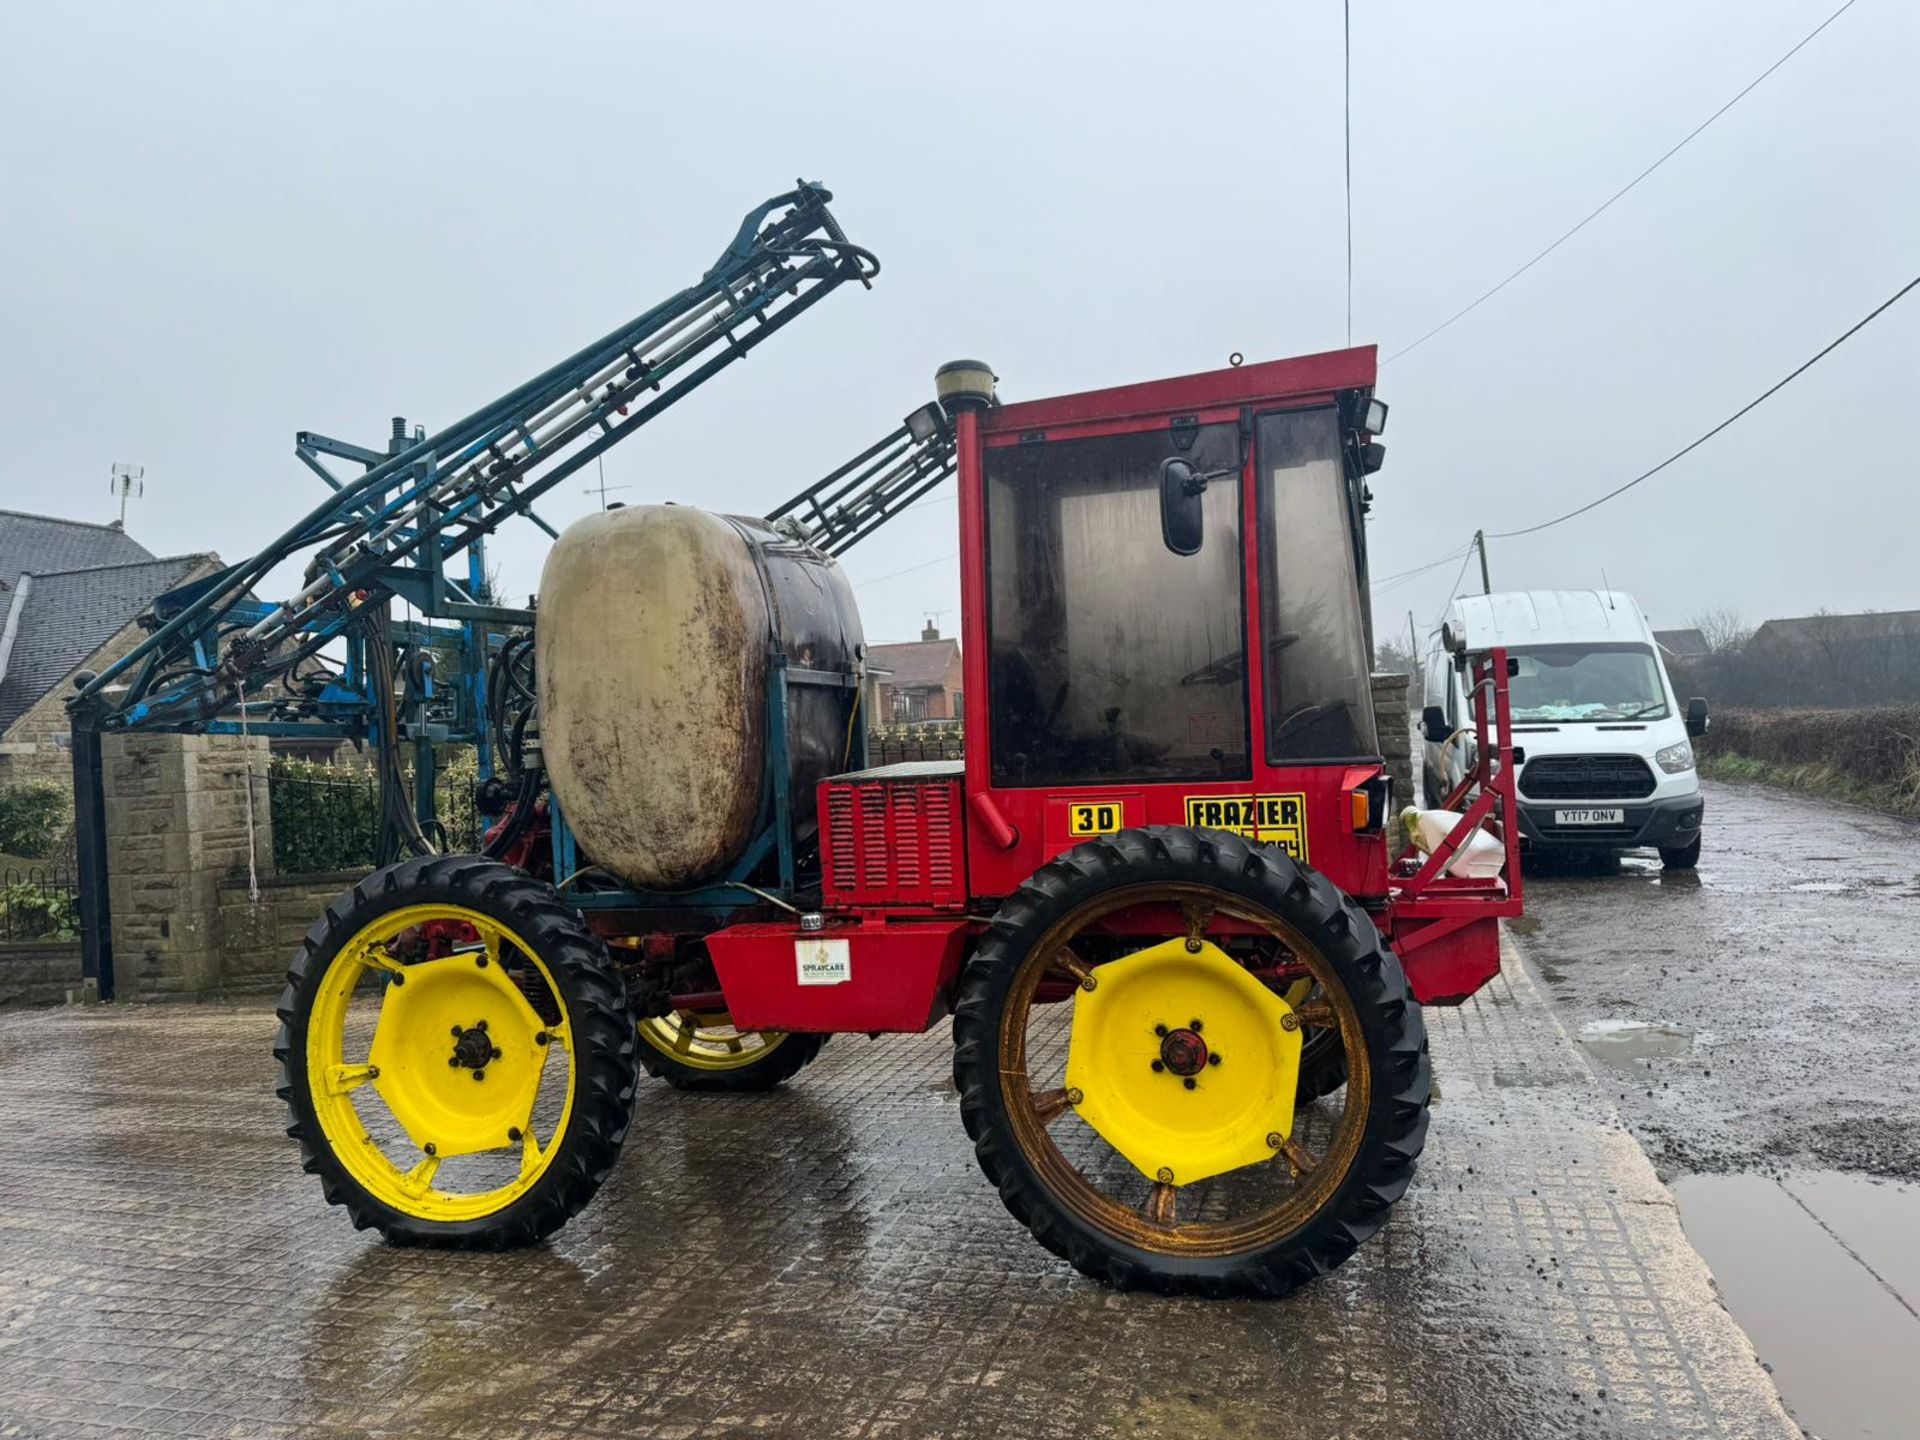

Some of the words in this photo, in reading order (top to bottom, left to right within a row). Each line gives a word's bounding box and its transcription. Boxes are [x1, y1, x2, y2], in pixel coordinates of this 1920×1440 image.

[1193, 801, 1298, 827] FRAZIER
[1562, 810, 1589, 822] YT17
[1592, 810, 1616, 822] ONV
[803, 964, 845, 972] SPRAYCARE
